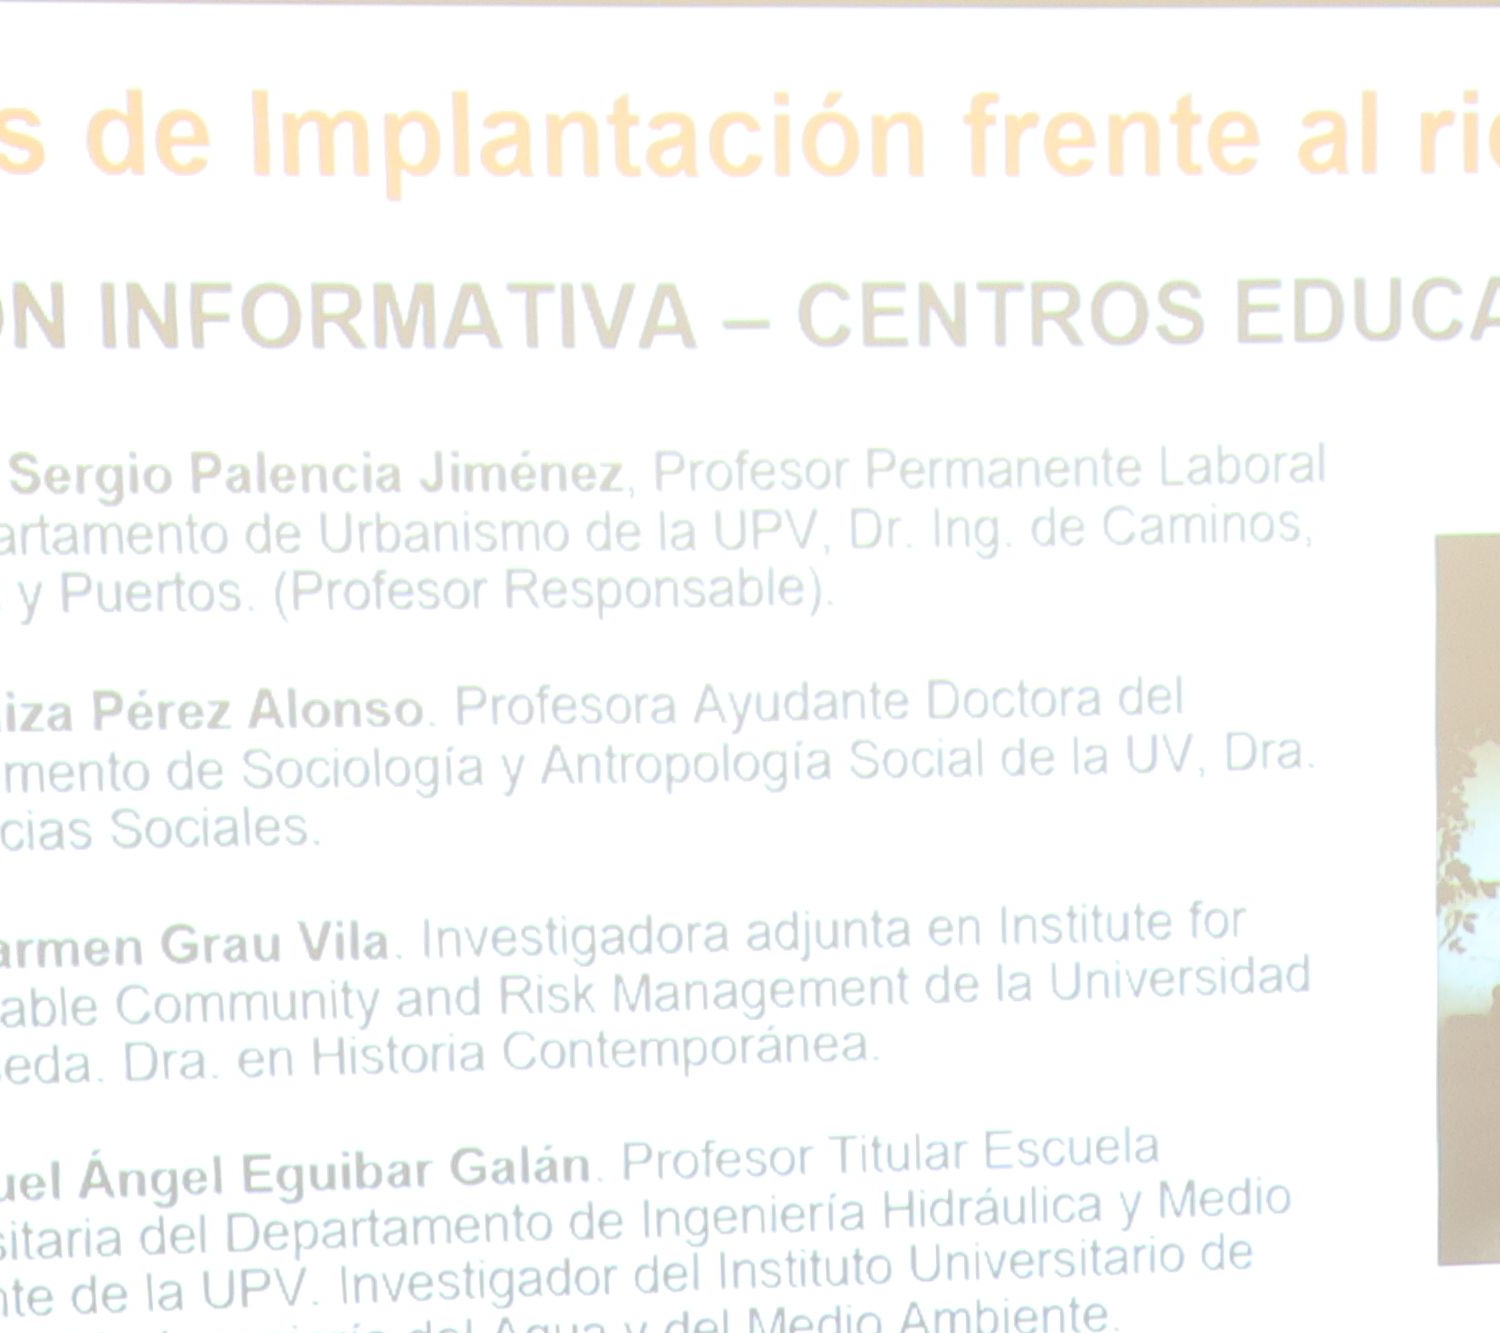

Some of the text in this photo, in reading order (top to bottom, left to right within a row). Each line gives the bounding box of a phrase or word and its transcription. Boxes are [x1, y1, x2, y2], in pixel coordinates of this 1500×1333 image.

[87, 86, 211, 176] de
[252, 88, 925, 202] Implantación
[963, 90, 1261, 177] frente
[1297, 88, 1378, 174] al
[100, 280, 697, 349] INFORMATIVA
[798, 278, 1204, 348] CENTROS
[9, 451, 172, 507] Sergio
[191, 450, 401, 494] Palencia
[420, 450, 634, 498] Jiménez,
[655, 448, 849, 491] Profesor
[867, 448, 1141, 489] Permanente
[1161, 442, 1325, 486] Laboral
[245, 512, 301, 554] de
[320, 511, 569, 553] Urbanismo
[586, 511, 640, 552] de
[660, 511, 695, 551] la
[715, 508, 830, 554] UPV,
[851, 507, 912, 549] Dr.
[935, 508, 1010, 560] Ing.
[1031, 506, 1084, 547] de
[1104, 504, 1311, 547] Caminos,
[17, 581, 42, 625] y
[61, 571, 253, 613] Puertos.
[275, 569, 488, 622] (Profesor
[506, 566, 832, 620] Responsable).
[93, 689, 232, 731] Pérez
[248, 687, 435, 729] Alonso.
[457, 684, 676, 726] Profesora
[694, 681, 909, 734] Ayudante
[928, 678, 1100, 719] Doctora
[1119, 675, 1182, 715] del
[167, 750, 223, 790] de
[243, 746, 483, 799] Sociología
[501, 754, 525, 797] y
[541, 740, 831, 794] Antropología
[850, 738, 983, 779] Social
[1001, 737, 1054, 777] de
[1074, 736, 1107, 775] la
[1127, 733, 1205, 777] UV,
[1226, 731, 1314, 771] Dra.
[111, 806, 320, 849] Sociales.
[161, 923, 280, 964] Grau
[297, 919, 402, 961] Vila.
[424, 914, 728, 967] Investigadora
[747, 910, 910, 962] adjunta
[928, 915, 980, 946] en
[1001, 903, 1172, 944] Institute
[1189, 900, 1247, 939] for
[116, 979, 380, 1030] Community
[396, 976, 480, 1017] and
[500, 974, 595, 1014] Risk
[614, 966, 909, 1020] Management
[925, 964, 979, 1003] de
[997, 963, 1031, 1002] la
[1051, 953, 1310, 1001] Universidad
[125, 1041, 219, 1082] Dra.
[238, 1046, 293, 1078] en
[313, 1033, 484, 1076] Historia
[504, 1024, 879, 1077] Contemporánea.
[78, 1148, 222, 1209] Ángel
[243, 1149, 433, 1205] Eguibar
[450, 1144, 602, 1186] Galán.
[623, 1139, 814, 1181] Profesor
[828, 1133, 968, 1173] Titular
[985, 1125, 1159, 1169] Escuela
[139, 1213, 206, 1255] del
[227, 1204, 553, 1261] Departamento
[569, 1200, 623, 1240] de
[643, 1192, 864, 1248] Ingeniería
[884, 1185, 1101, 1229] Hidráulica
[1120, 1190, 1142, 1232] y
[1160, 1177, 1291, 1218] Medio
[71, 1274, 128, 1315] de
[146, 1272, 183, 1312] la
[203, 1265, 318, 1309] UPV.
[341, 1257, 618, 1309] Investigador
[634, 1252, 699, 1294] del
[720, 1248, 892, 1289] Instituto
[910, 1235, 1185, 1282] Universitario
[1201, 1232, 1254, 1271] de
